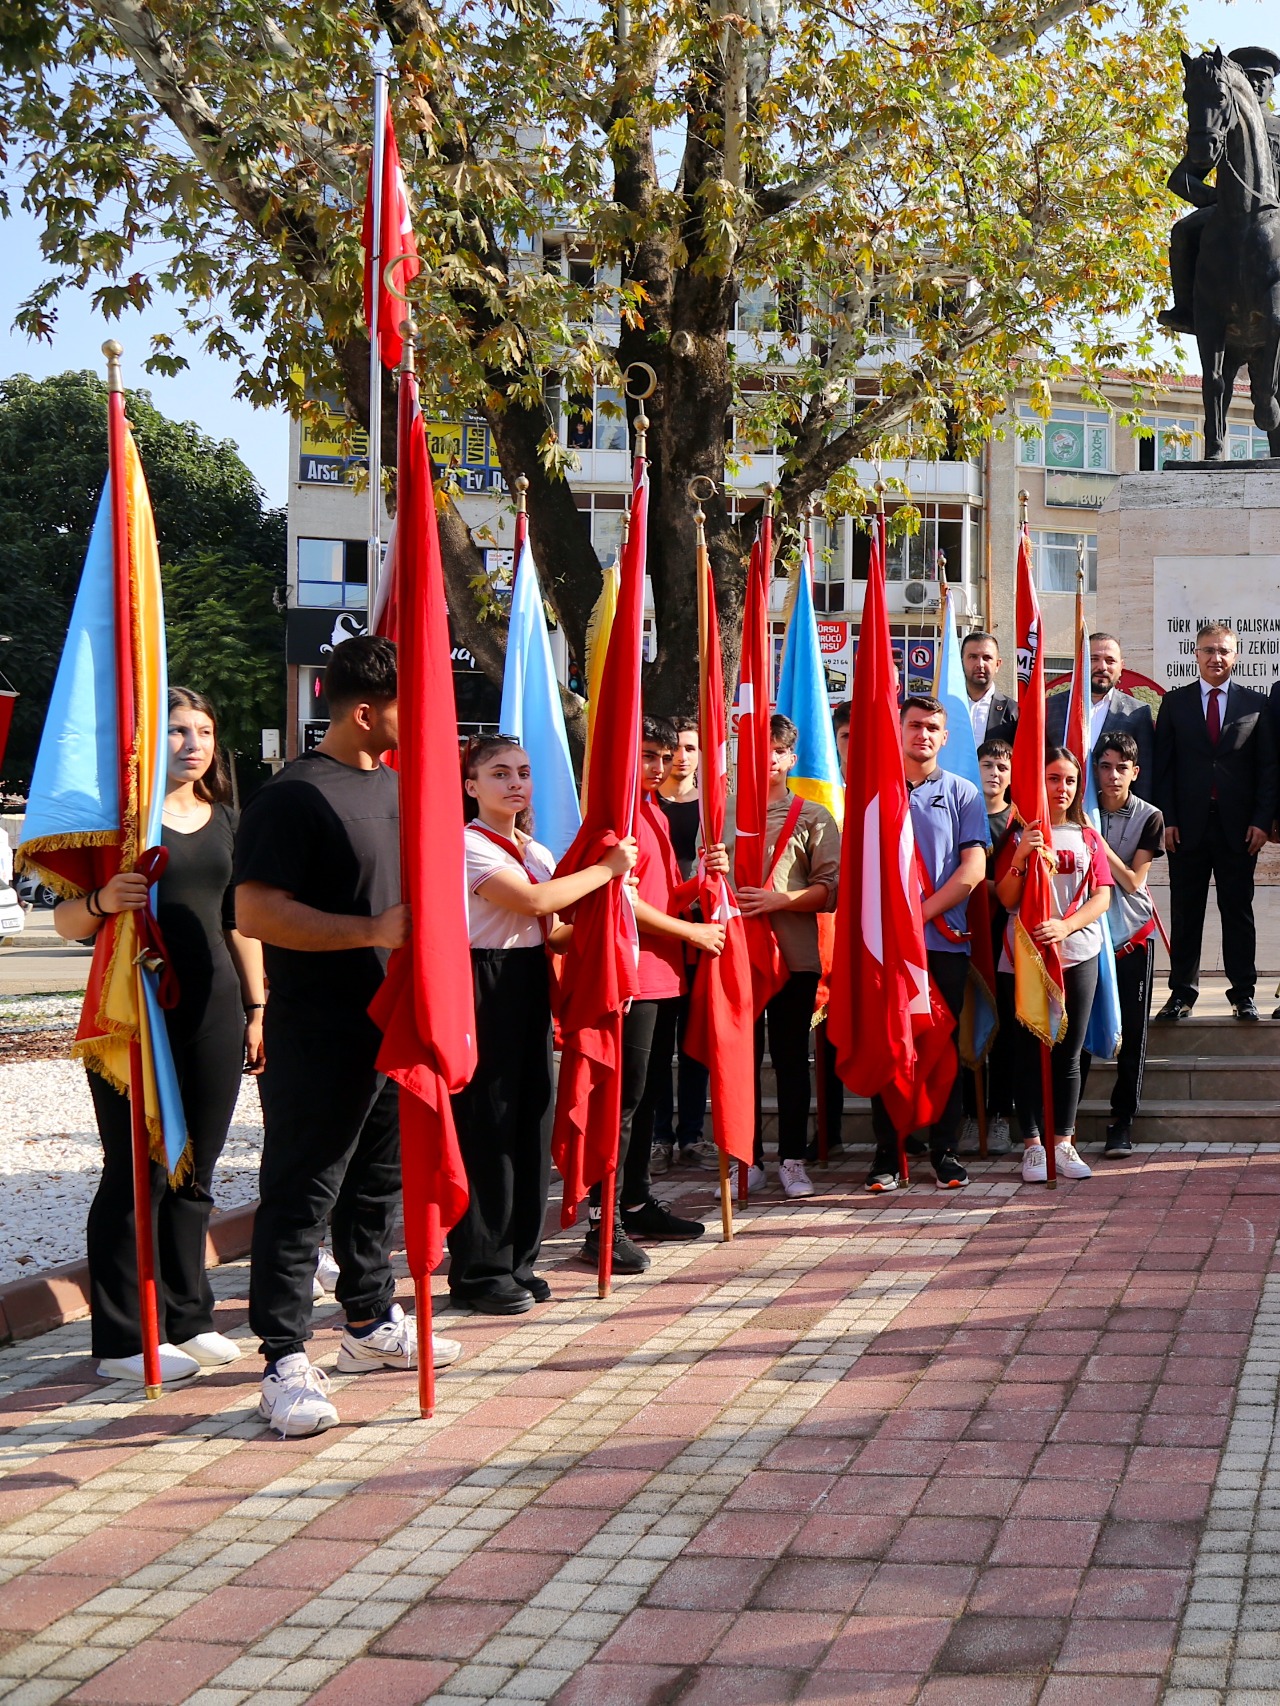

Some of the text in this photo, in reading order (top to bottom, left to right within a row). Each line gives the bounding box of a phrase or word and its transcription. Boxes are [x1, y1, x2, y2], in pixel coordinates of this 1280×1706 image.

[468, 428, 485, 462] Villa
[1092, 429, 1102, 466] TEXAS
[307, 460, 338, 480] Arsa
[466, 470, 484, 490] Ev
[818, 624, 840, 633] ÜRSU
[1167, 617, 1192, 634] TÜRK
[820, 633, 842, 643] RÜCÜ
[1178, 638, 1196, 655] TÜR
